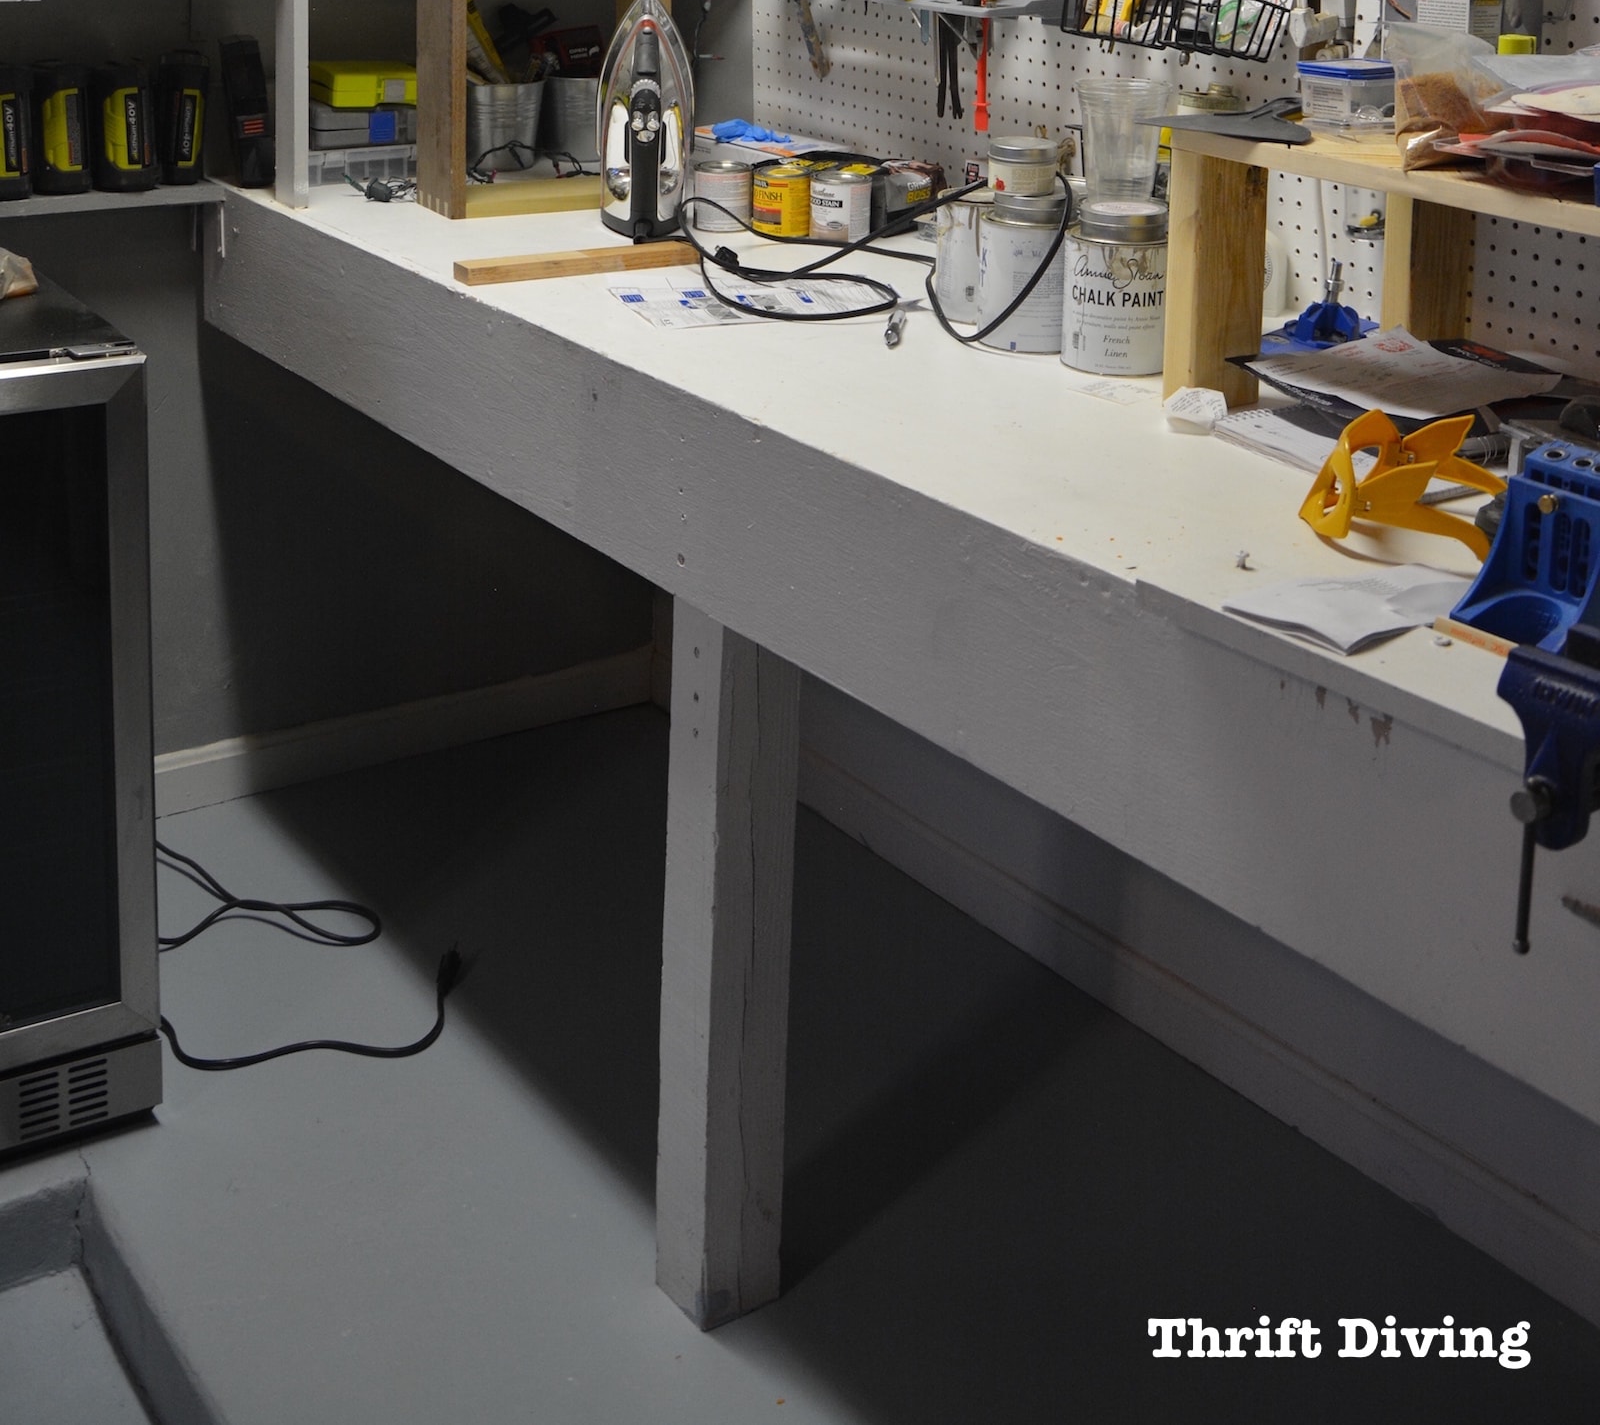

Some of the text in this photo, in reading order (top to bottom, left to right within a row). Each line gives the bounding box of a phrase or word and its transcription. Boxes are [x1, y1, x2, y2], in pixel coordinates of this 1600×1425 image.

[758, 190, 783, 202] FINISH
[907, 186, 931, 204] BOSS
[811, 197, 839, 207] OOD STAIN
[1072, 285, 1116, 307] CHALK
[1122, 290, 1164, 307] PAINT
[1103, 334, 1131, 345] French
[1104, 348, 1128, 359] Linen
